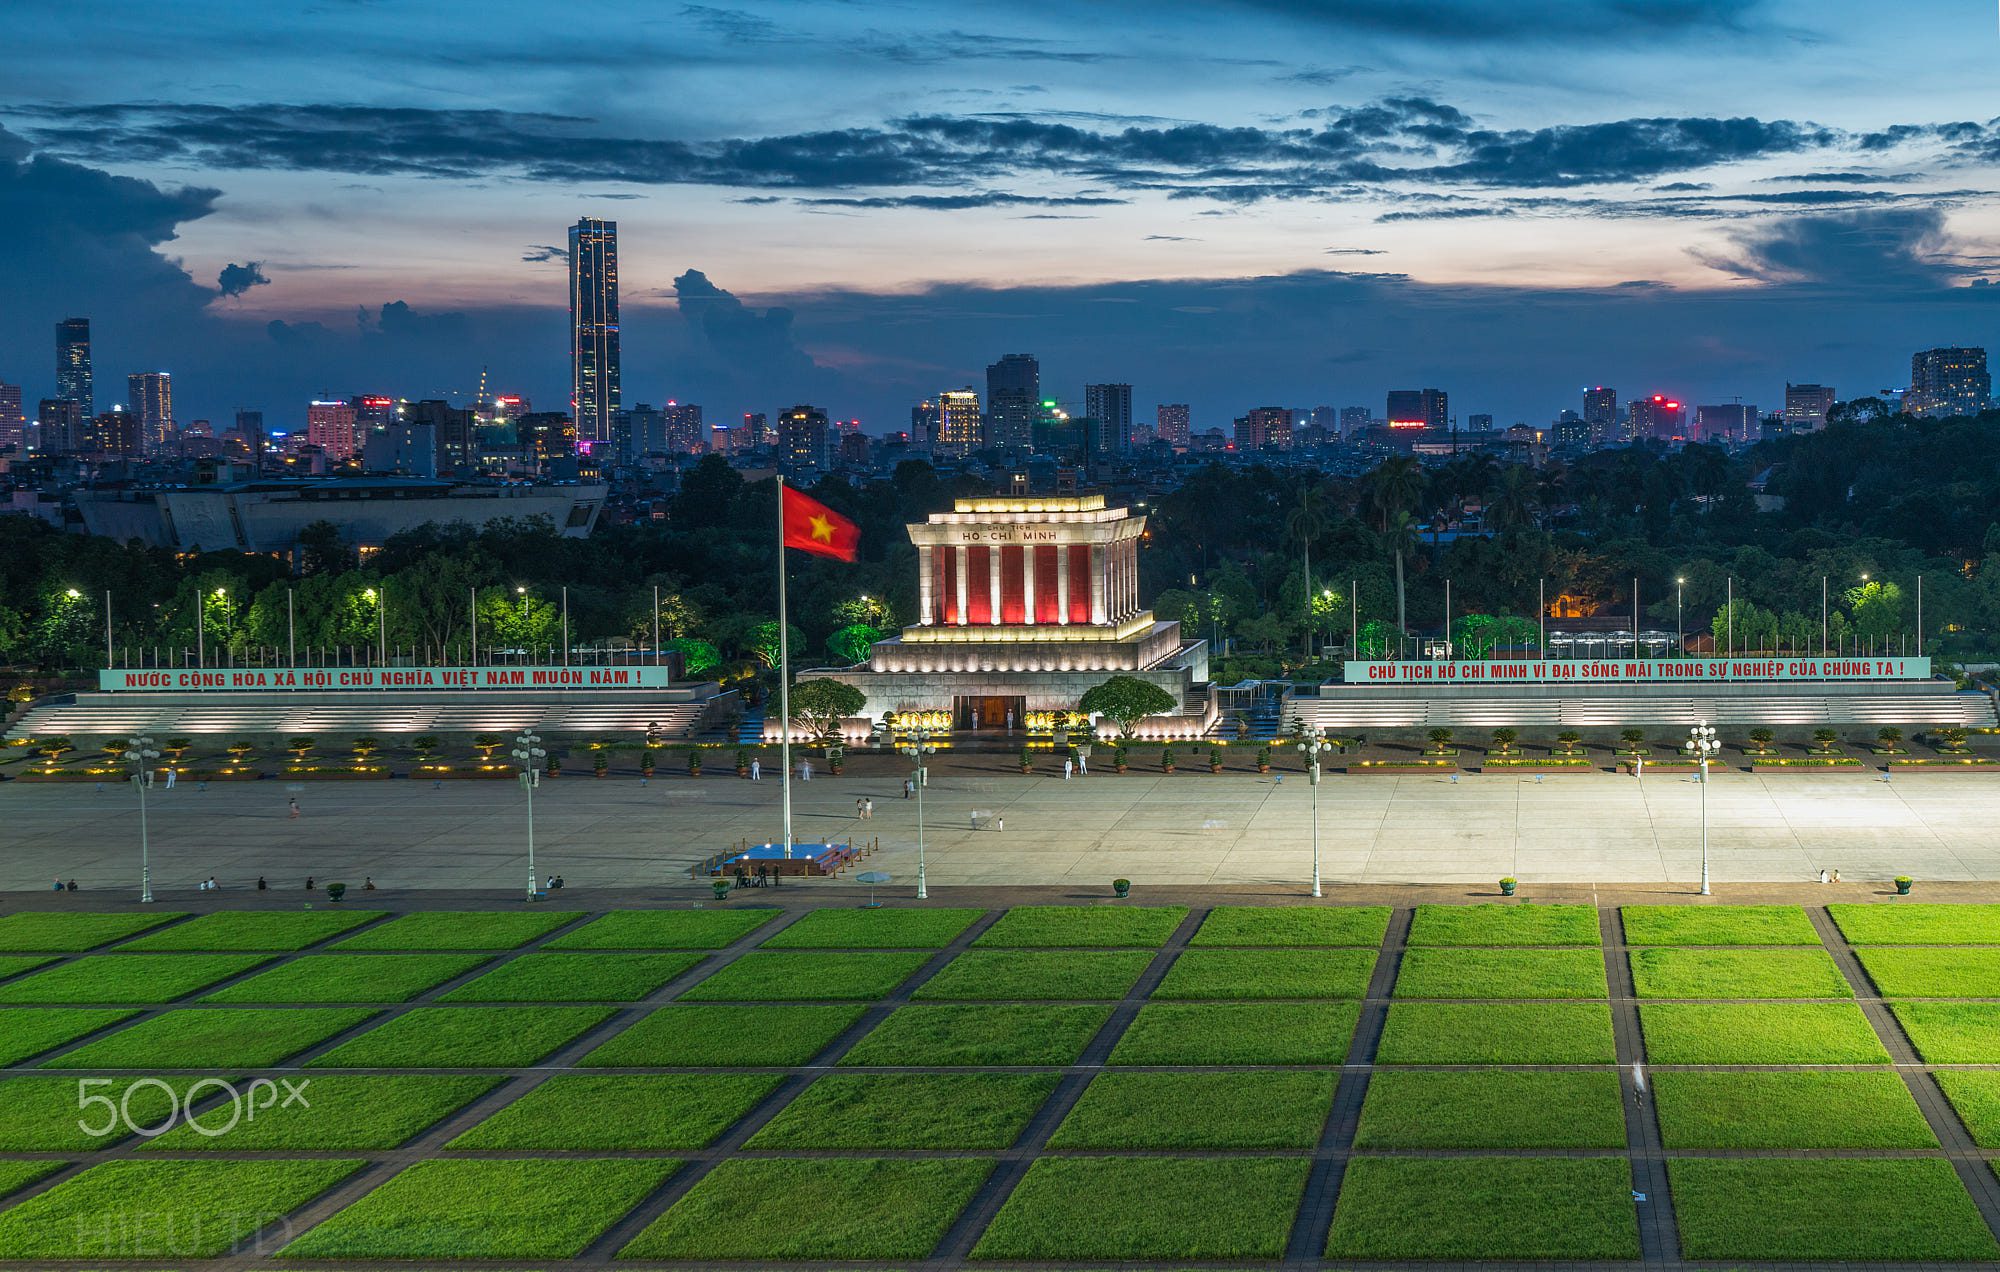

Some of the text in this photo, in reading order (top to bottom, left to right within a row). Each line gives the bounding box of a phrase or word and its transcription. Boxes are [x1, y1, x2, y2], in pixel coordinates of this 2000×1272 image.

[126, 671, 170, 687] NƯỚC
[179, 671, 224, 688] CỘNG
[233, 671, 266, 687] HÒA
[274, 670, 296, 686] XÃ
[304, 670, 332, 688] HỘI
[340, 669, 373, 686] CHỦ
[381, 669, 433, 686] NGHĨA
[442, 669, 479, 687] VIỆT
[487, 671, 525, 685] NAM
[532, 669, 582, 685] MUÔN
[590, 669, 629, 684] NĂM
[1368, 662, 1396, 679] CHỦ
[1402, 664, 1432, 681] TỊCH
[1462, 662, 1485, 678] CHÍ
[1491, 664, 1527, 678] MINH
[1552, 664, 1575, 681] ĐẠI
[1582, 660, 1619, 678] SỐNG
[1626, 661, 1651, 677] MÃI
[1658, 663, 1703, 677] TRONG
[1710, 661, 1728, 679] SỰ
[1732, 660, 1784, 678] NGHIỆP
[1789, 659, 1817, 677] CỦA
[1823, 660, 1870, 676] CHÚNG
[1876, 662, 1894, 676] TA
